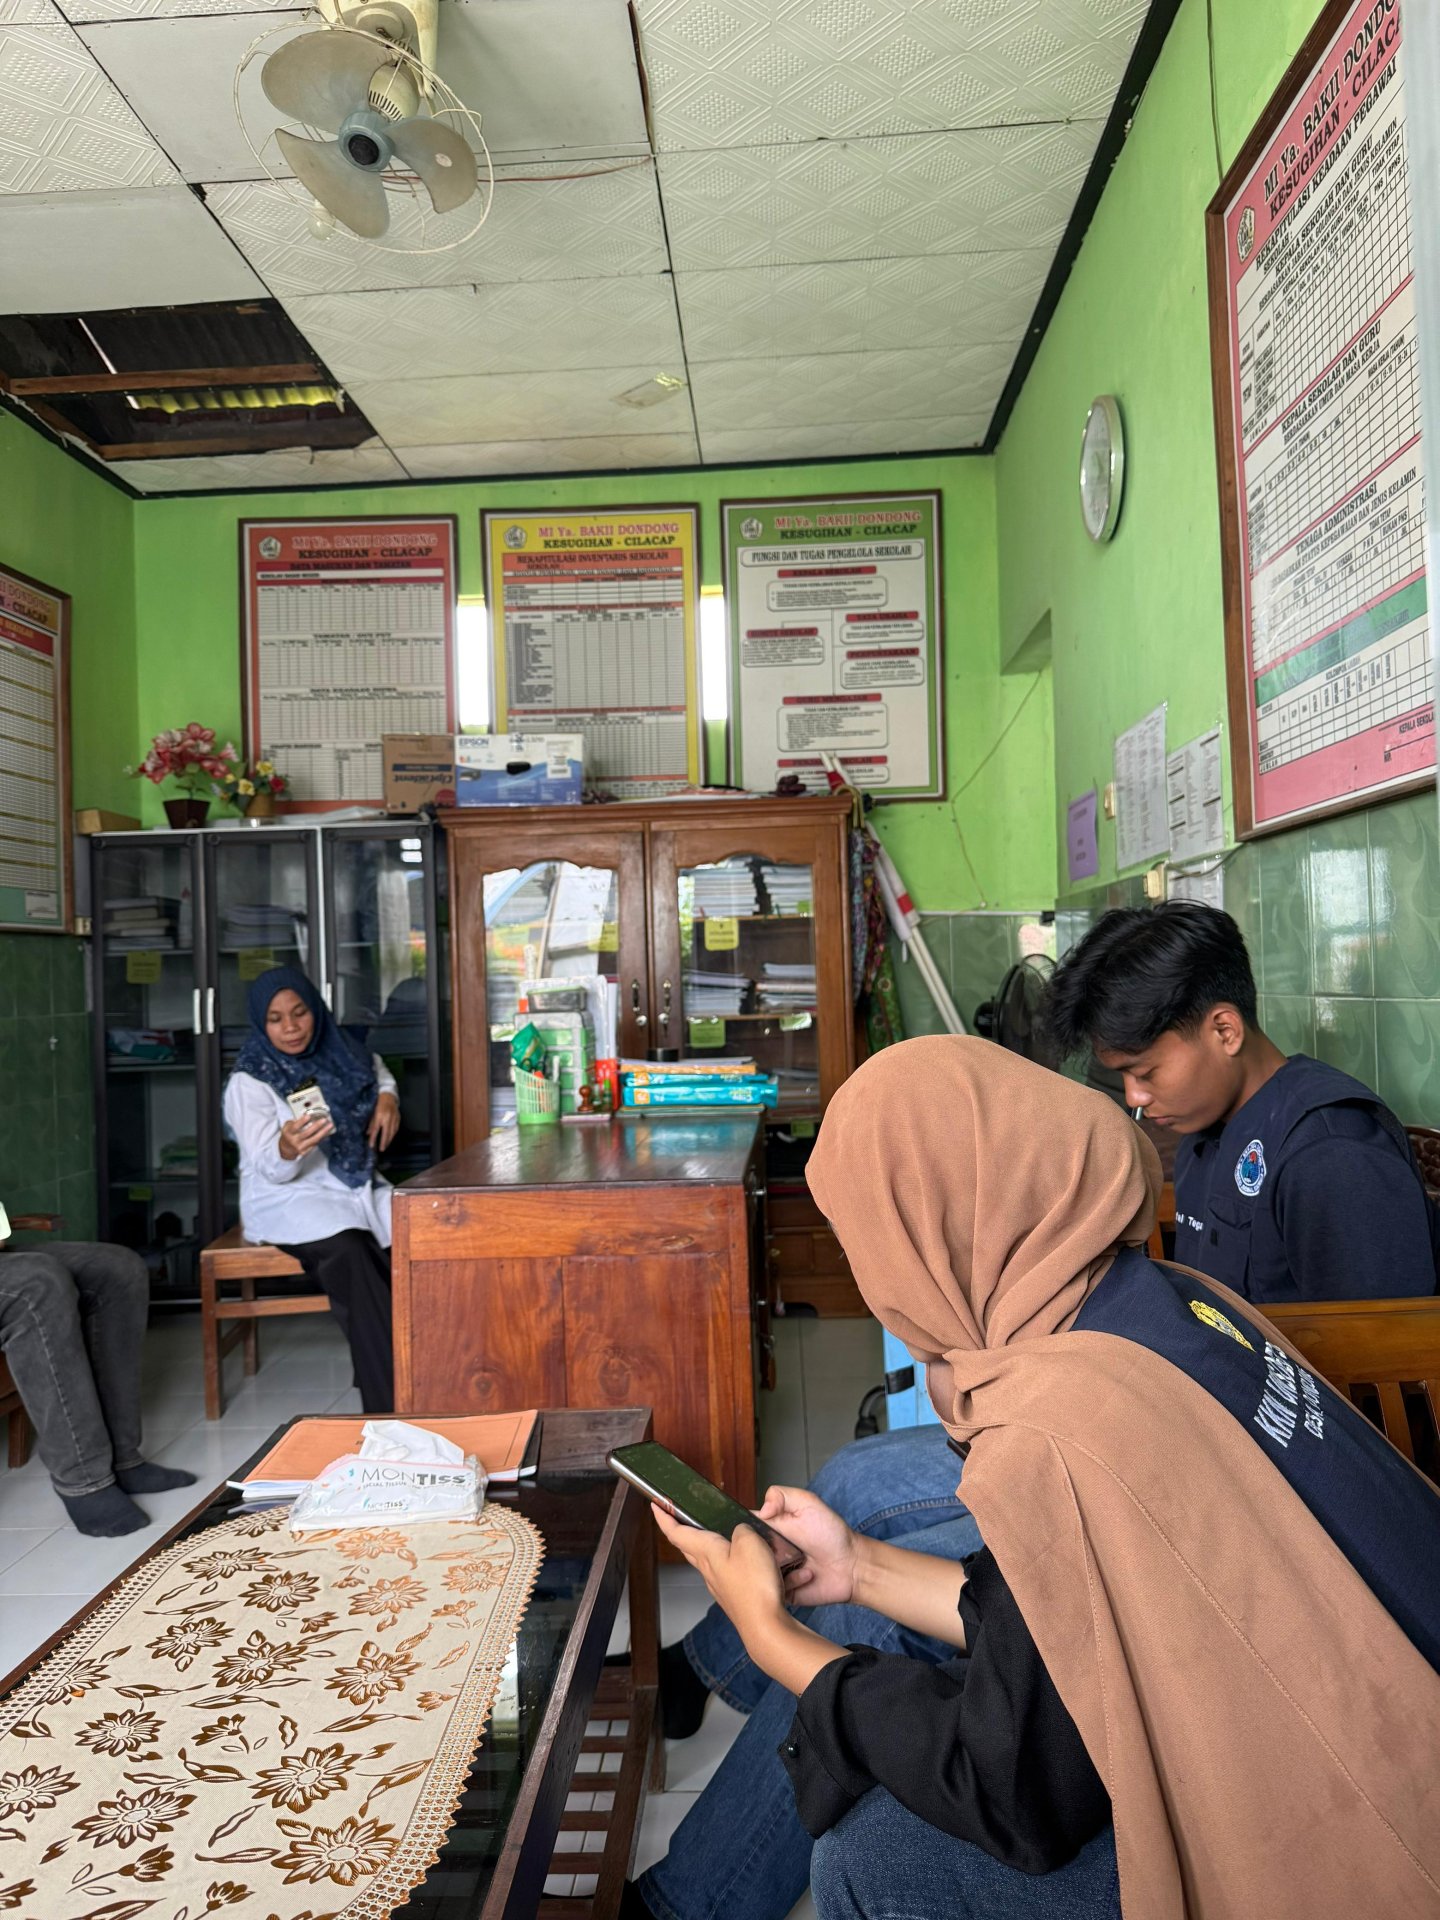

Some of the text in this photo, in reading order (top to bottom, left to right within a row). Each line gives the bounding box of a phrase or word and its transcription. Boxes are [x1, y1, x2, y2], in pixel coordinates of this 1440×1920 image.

[1264, 160, 1278, 205] MI
[1280, 139, 1299, 180] Ya.
[1302, 65, 1340, 148] BAKII
[1372, 132, 1400, 179] TIDAK TETAP
[1256, 54, 1396, 272] REKAPITULASI KEADAAN PEGAWAI
[1270, 102, 1339, 223] KESUGIHAN
[1259, 261, 1290, 312] BERDASARKAN
[1315, 193, 1341, 239] GOLONGAN
[1342, 176, 1353, 203] DAN
[1353, 154, 1369, 187] JENIS
[1370, 115, 1396, 163] KELAMIN
[1275, 133, 1372, 277] KEPALA SEKOLAH DAN GURU
[1263, 231, 1289, 276] SEKOLAH
[1282, 188, 1359, 296] KEPALA SEKOLAH DAN GURU TETAP
[1282, 318, 1381, 434] KEPALA SEKOLAH DAN GURU
[1283, 336, 1380, 446] BERDASARKAN UMUR DAN MASA KERJA
[538, 527, 554, 538] MI
[618, 523, 679, 535] DONDONG
[775, 516, 791, 529] MI
[856, 511, 921, 525] DONDONG
[780, 528, 851, 540] KESUGIHAN
[864, 524, 917, 536] CILACAP
[1296, 480, 1377, 556] TENAGA ADMINISTRASI
[1301, 542, 1320, 566] STATUS
[1320, 512, 1357, 552] KEPEGAWAIAN
[1358, 503, 1369, 522] DAN
[1370, 488, 1387, 513] JENIS
[1388, 465, 1416, 499] KELAMIN
[1398, 508, 1407, 525] PNS
[298, 549, 369, 560] KESUGIHAN
[380, 547, 433, 558] CILACAP
[372, 533, 438, 548] DONDONG
[544, 538, 613, 549] KESUGIHAN
[624, 535, 675, 546] CILACAP
[629, 551, 669, 561] SEKOLAH
[752, 545, 912, 562] FUNGSI DAN TUGAS PENGELOLA SEKOLAH
[459, 738, 489, 746] EPSON
[1254, 1388, 1298, 1448] KKN
[362, 1467, 466, 1486] MONTISS
